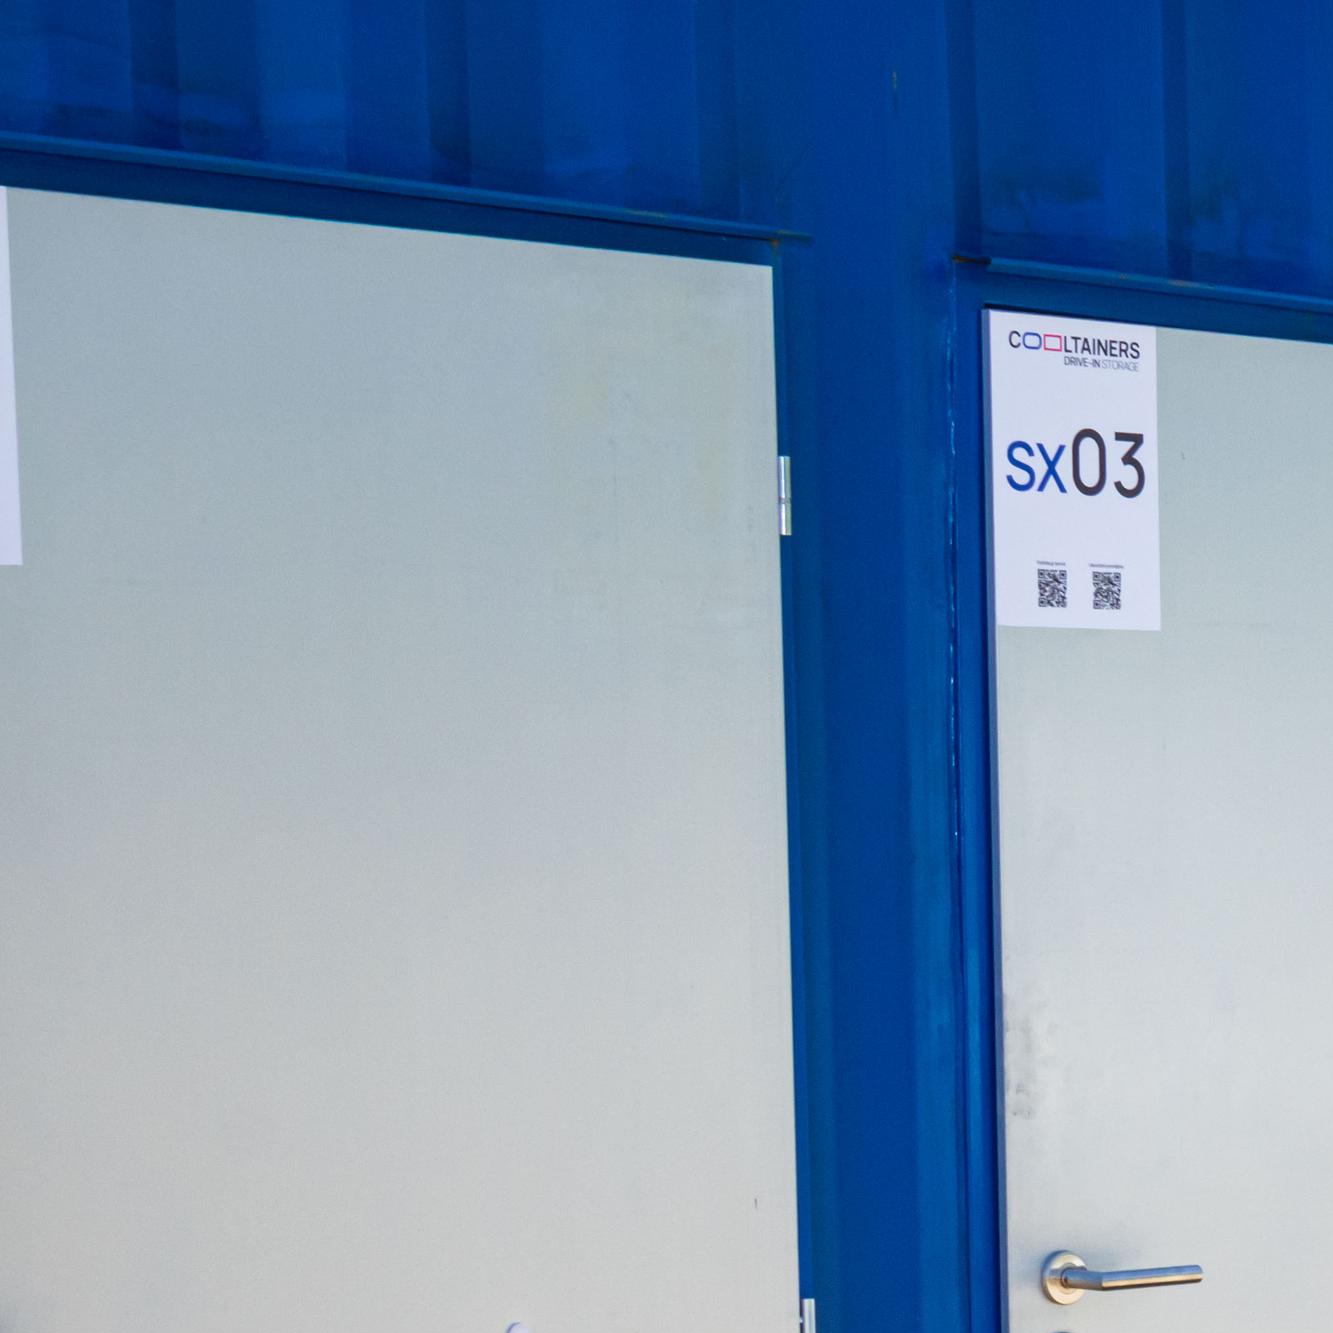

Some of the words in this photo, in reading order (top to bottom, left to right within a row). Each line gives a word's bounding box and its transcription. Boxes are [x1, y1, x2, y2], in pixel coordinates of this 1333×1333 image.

[1008, 330, 1140, 360] COOLTAINERS
[1063, 356, 1101, 368] DRIVE-IN
[1101, 360, 1139, 373] STORAGE
[1006, 428, 1145, 498] SX03
